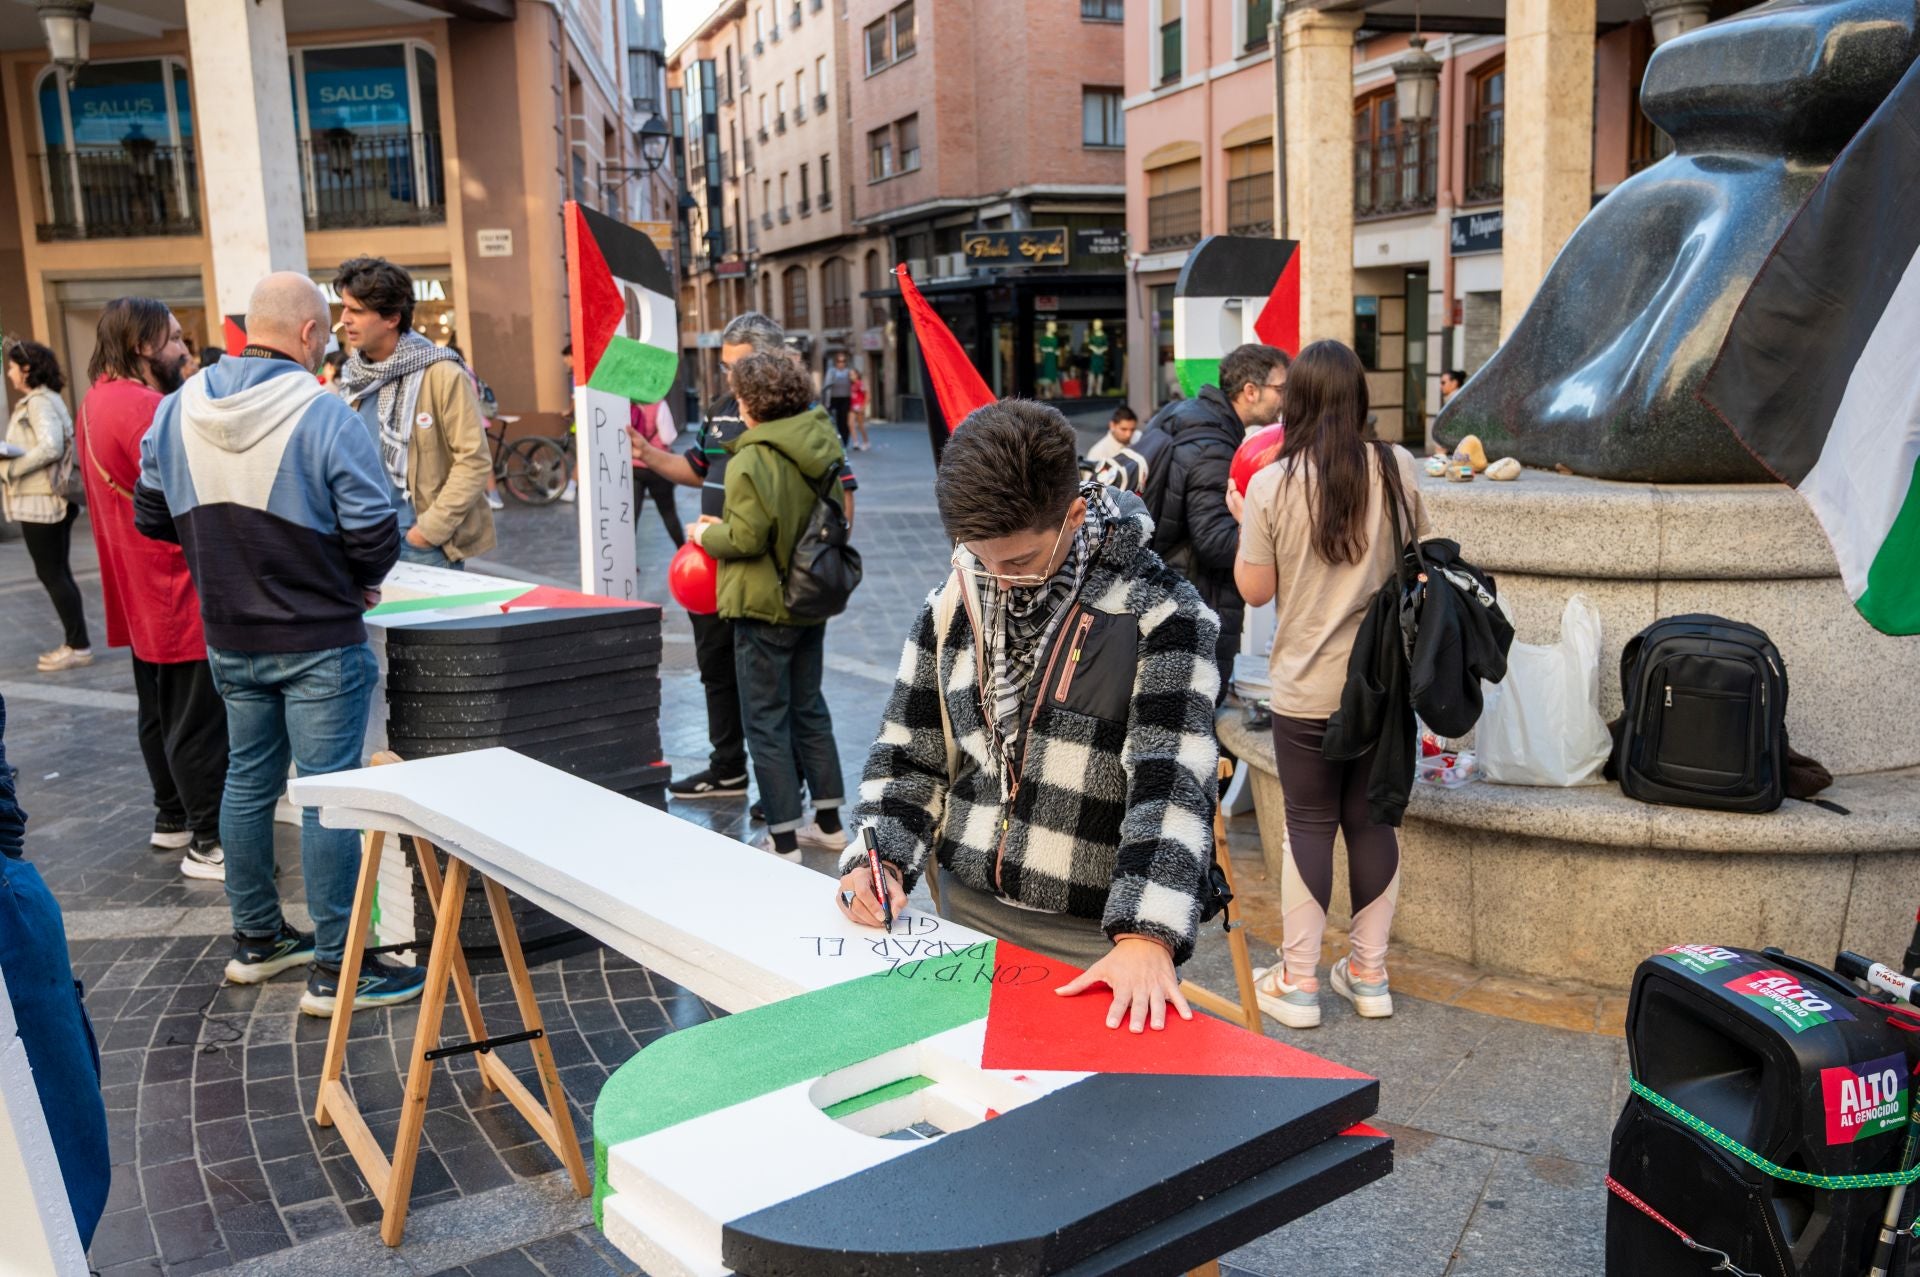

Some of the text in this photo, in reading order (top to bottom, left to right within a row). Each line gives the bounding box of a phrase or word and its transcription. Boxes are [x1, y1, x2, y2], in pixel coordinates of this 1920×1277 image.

[320, 82, 395, 103] SALUS
[84, 97, 153, 118] SALUS
[617, 428, 630, 524] PAZ
[799, 936, 988, 960] PARAR EL
[871, 956, 925, 979] DE
[973, 963, 1050, 986] CON
[1746, 981, 1809, 1017] AL GENOCIDIO
[1758, 976, 1833, 1012] ALTO
[1840, 1068, 1898, 1114] ALTO
[1840, 1101, 1899, 1128] AL GENOCIDIO
[1886, 1115, 1906, 1126] Podemos
